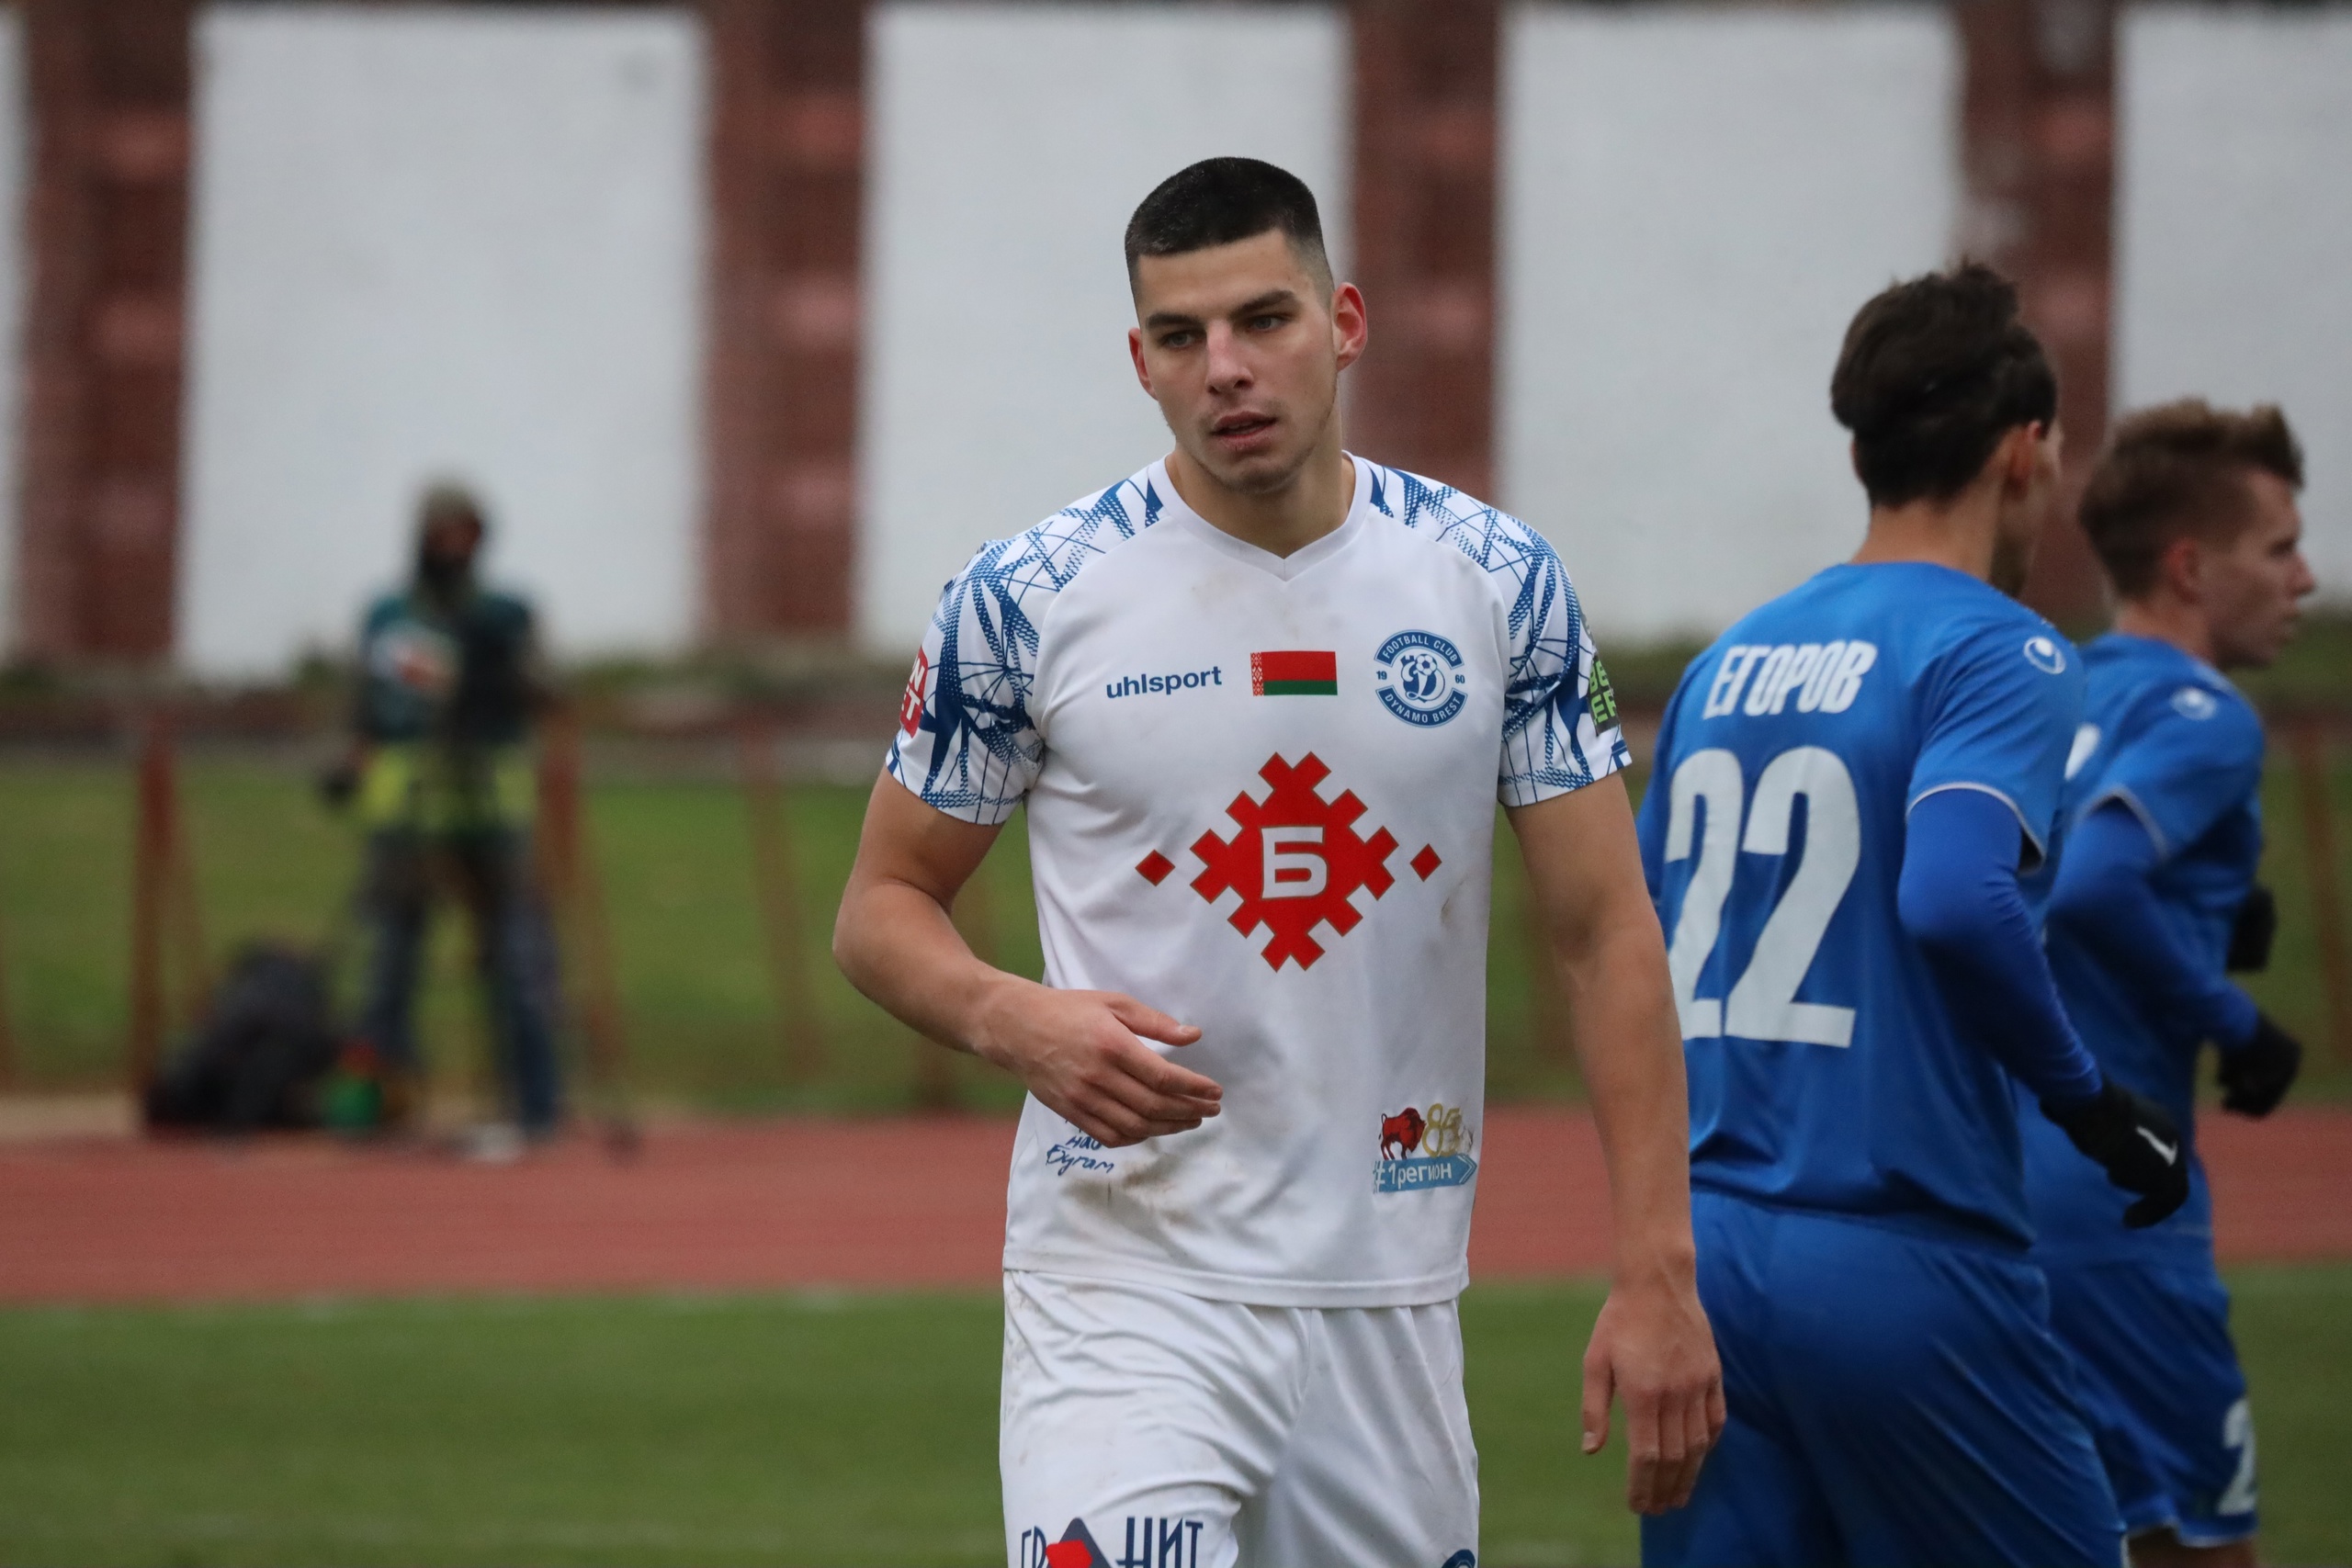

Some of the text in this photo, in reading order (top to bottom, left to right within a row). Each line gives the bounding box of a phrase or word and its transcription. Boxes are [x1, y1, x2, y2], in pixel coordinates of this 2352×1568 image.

[1382, 634, 1458, 662] FOOTBALL CLUB
[1105, 666, 1223, 699] uhlsport
[1375, 671, 1388, 681] 19
[1454, 674, 1466, 684] 60
[1702, 639, 1878, 720] ЕГОРОВ
[1385, 694, 1461, 724] DYNAMO BREST
[1664, 745, 1861, 1048] 22
